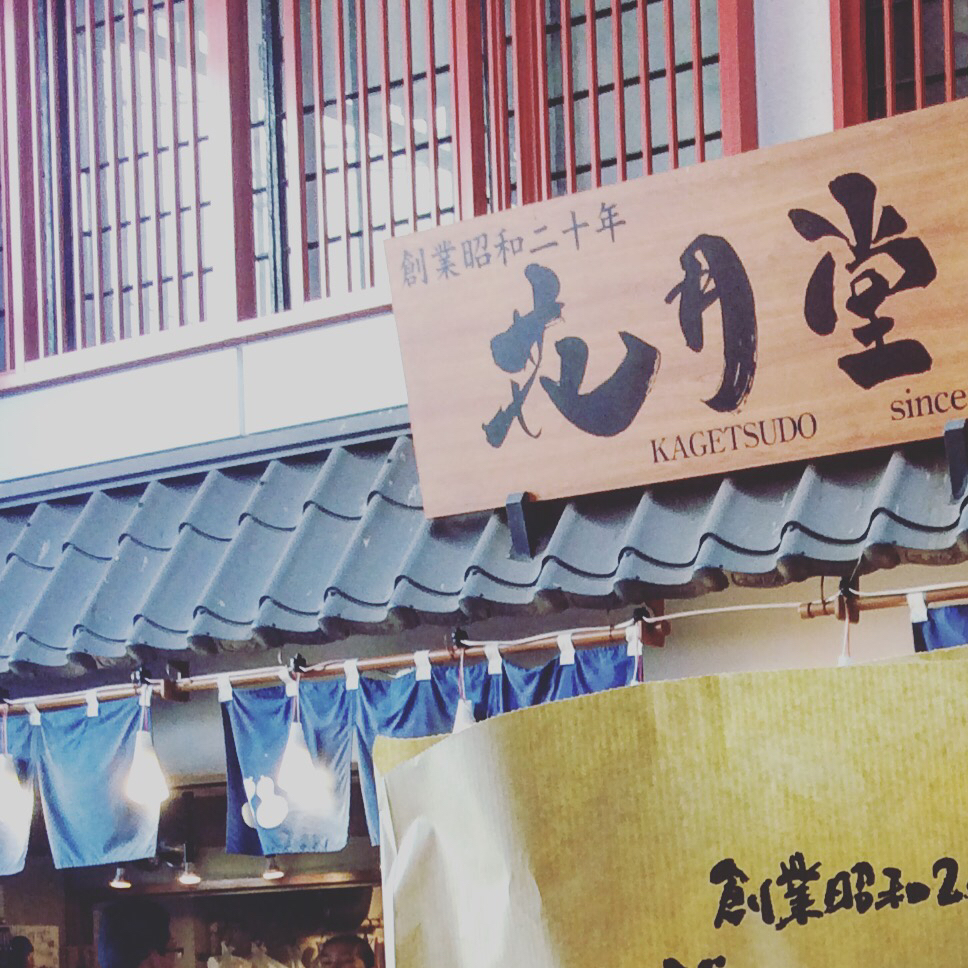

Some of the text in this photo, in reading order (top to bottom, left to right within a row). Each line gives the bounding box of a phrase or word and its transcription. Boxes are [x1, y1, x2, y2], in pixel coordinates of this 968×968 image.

[401, 202, 627, 288] 創業昭和二十年
[481, 172, 938, 448] 花月堂
[889, 384, 968, 423] since
[650, 412, 818, 465] KAGETSUDO
